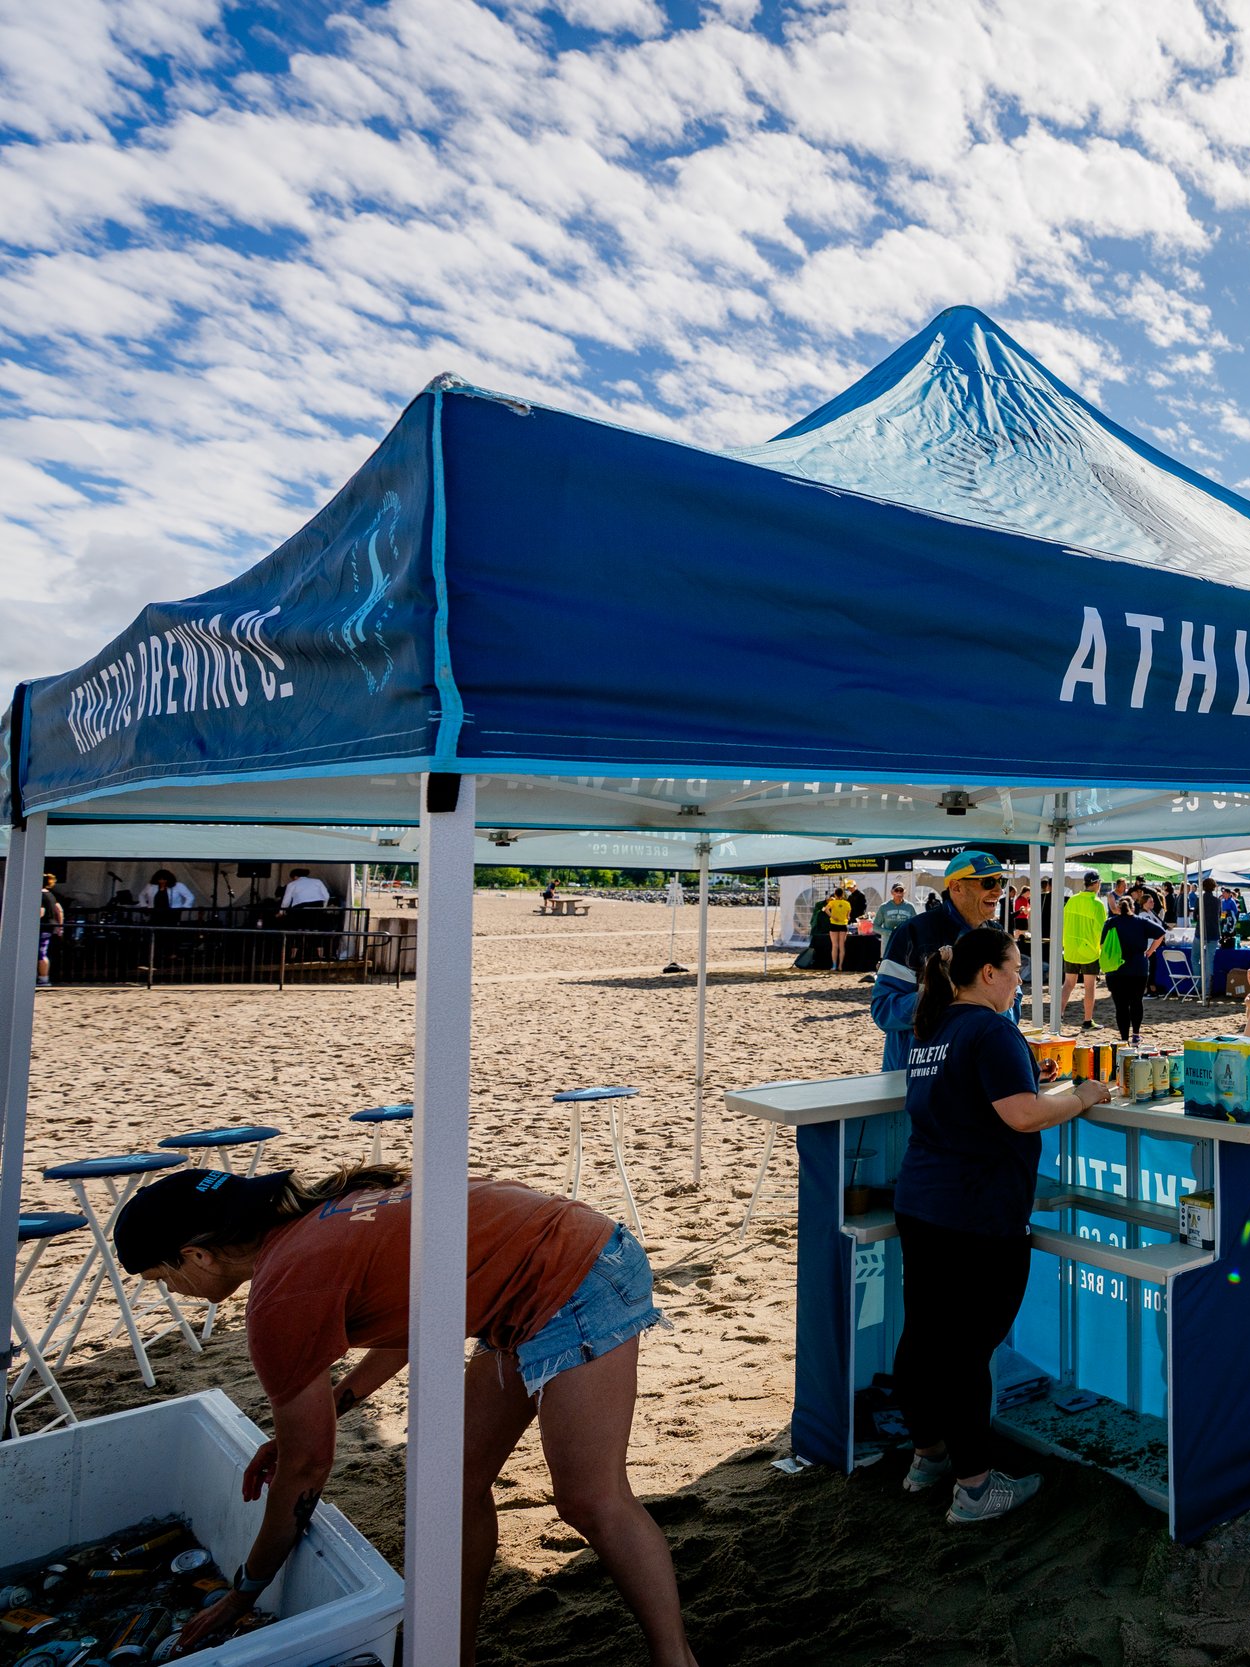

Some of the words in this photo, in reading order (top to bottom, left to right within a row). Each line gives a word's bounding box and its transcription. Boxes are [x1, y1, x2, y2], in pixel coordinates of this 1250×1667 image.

[68, 651, 136, 755] ATHLETIC
[137, 613, 249, 721] BREWING
[820, 863, 842, 871] Sports
[1185, 1067, 1213, 1080] ATHLETIC
